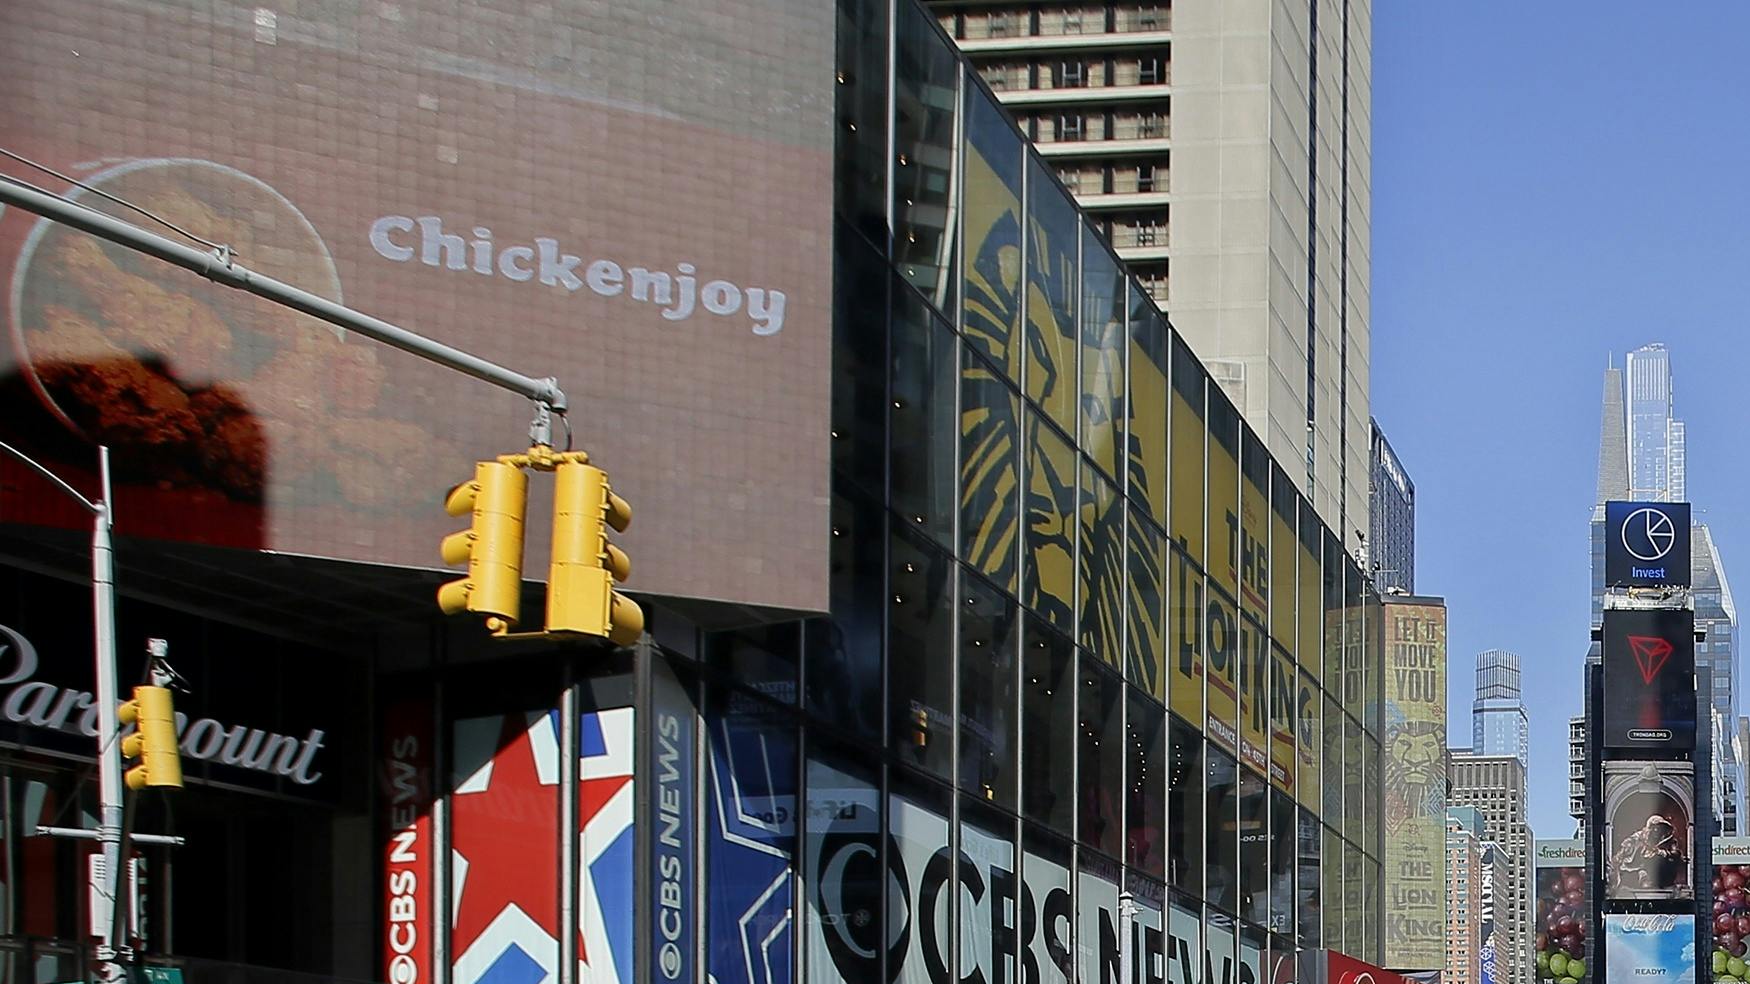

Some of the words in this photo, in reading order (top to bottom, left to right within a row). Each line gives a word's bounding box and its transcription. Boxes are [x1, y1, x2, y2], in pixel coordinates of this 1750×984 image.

[369, 213, 786, 337] Chickenjoy
[1226, 508, 1268, 601] THE
[1632, 566, 1666, 579] Invest
[1178, 534, 1249, 696] LION
[1252, 610, 1314, 750] KING
[1394, 644, 1436, 668] MOVE
[1395, 616, 1420, 642] LET
[0, 622, 326, 785] araount
[1394, 669, 1436, 703] YOU
[389, 735, 417, 863] NEWS
[658, 713, 684, 848] NEWS
[1392, 883, 1437, 911] LION
[1400, 860, 1433, 877] THE
[388, 871, 417, 953] CBS
[658, 856, 683, 942] CBS
[1387, 912, 1442, 943] KING
[1634, 967, 1667, 976] READY?
